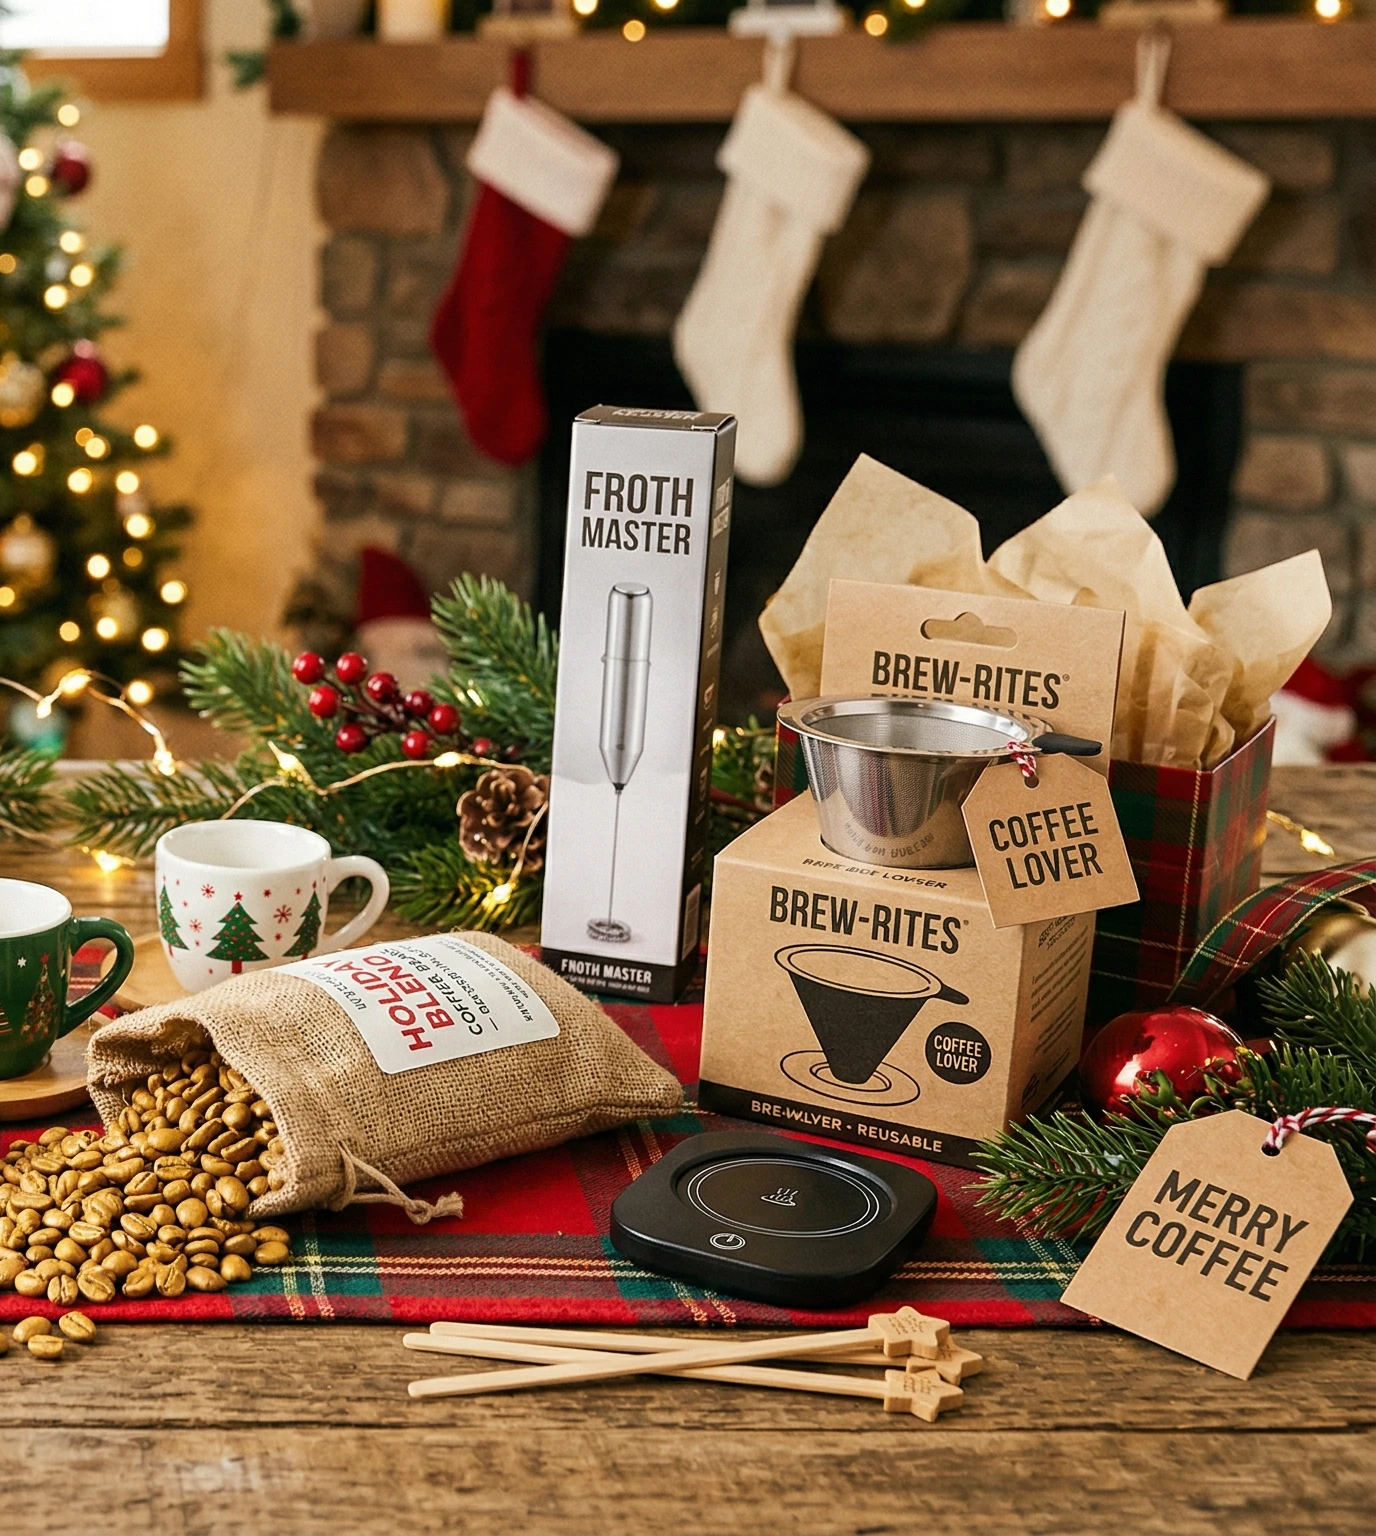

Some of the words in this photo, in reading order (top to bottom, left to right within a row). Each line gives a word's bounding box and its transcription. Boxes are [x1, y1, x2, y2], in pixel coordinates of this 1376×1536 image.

[584, 471, 694, 517] FROTH
[581, 517, 691, 555] MASTER
[988, 801, 1100, 852] COFFEE
[1005, 842, 1104, 890] LOVER
[603, 964, 652, 985] MASTER
[312, 960, 434, 1052] HOLIDAY
[934, 1034, 983, 1058] COFFEE
[936, 1051, 978, 1074] LOVER
[857, 1123, 942, 1153] REUSABLE
[1153, 1169, 1310, 1254] MERRY
[1125, 1210, 1289, 1302] COFFEE
